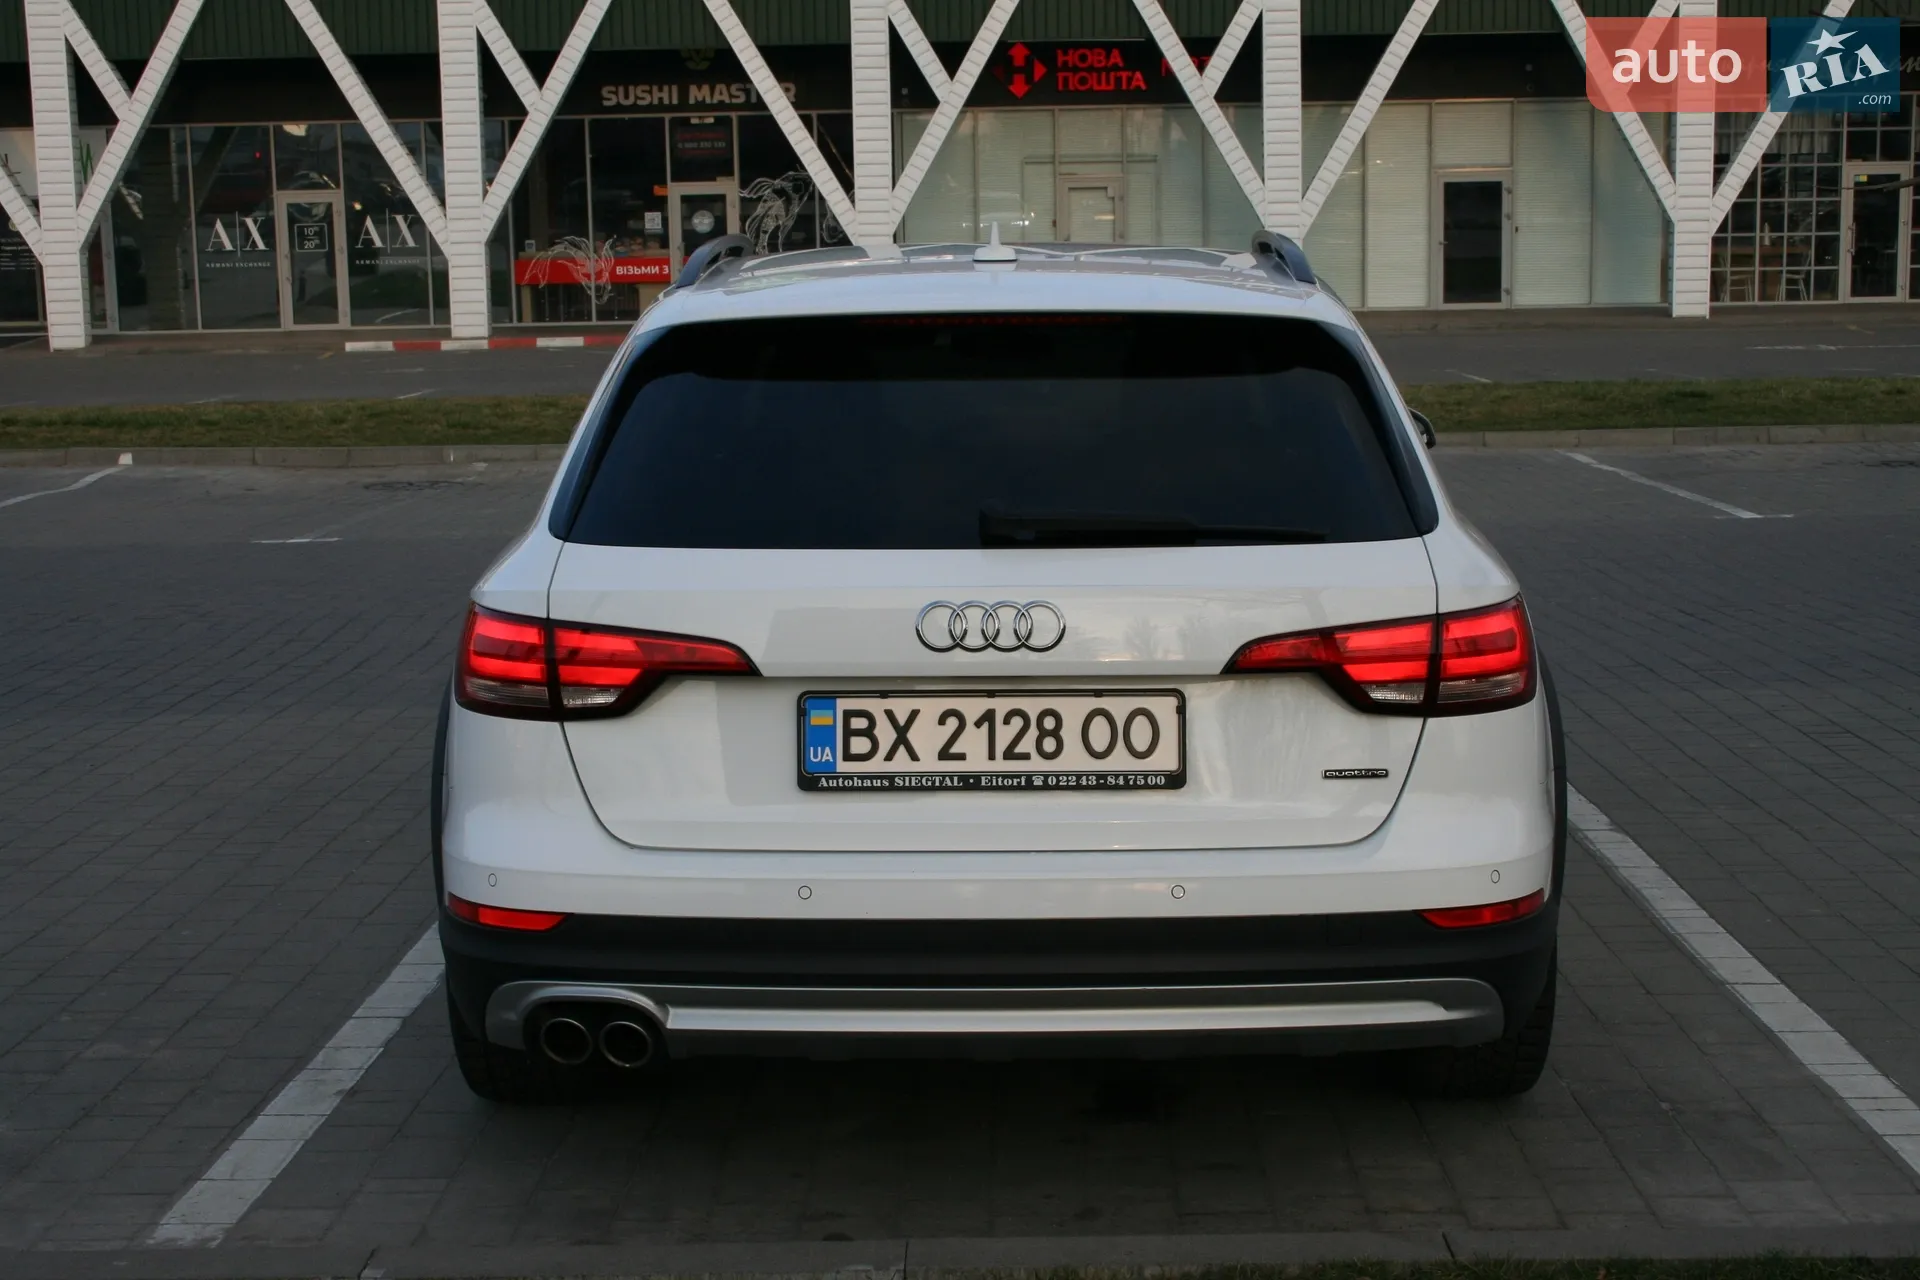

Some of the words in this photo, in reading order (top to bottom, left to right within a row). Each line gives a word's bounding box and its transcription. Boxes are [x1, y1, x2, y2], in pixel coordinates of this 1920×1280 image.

[1056, 48, 1125, 68] НОВА
[1056, 71, 1147, 91] ПОШТА
[600, 85, 679, 106] SUSHI
[688, 83, 797, 104] MASTR
[616, 264, 659, 275] ВІЗЬМИ
[810, 746, 834, 762] UA
[842, 708, 921, 762] BX
[937, 707, 1064, 761] 2128
[818, 776, 890, 787] Autohaus
[894, 775, 964, 787] SIEGTAL
[980, 775, 1027, 786] Eitorf
[1325, 769, 1387, 777] quattro
